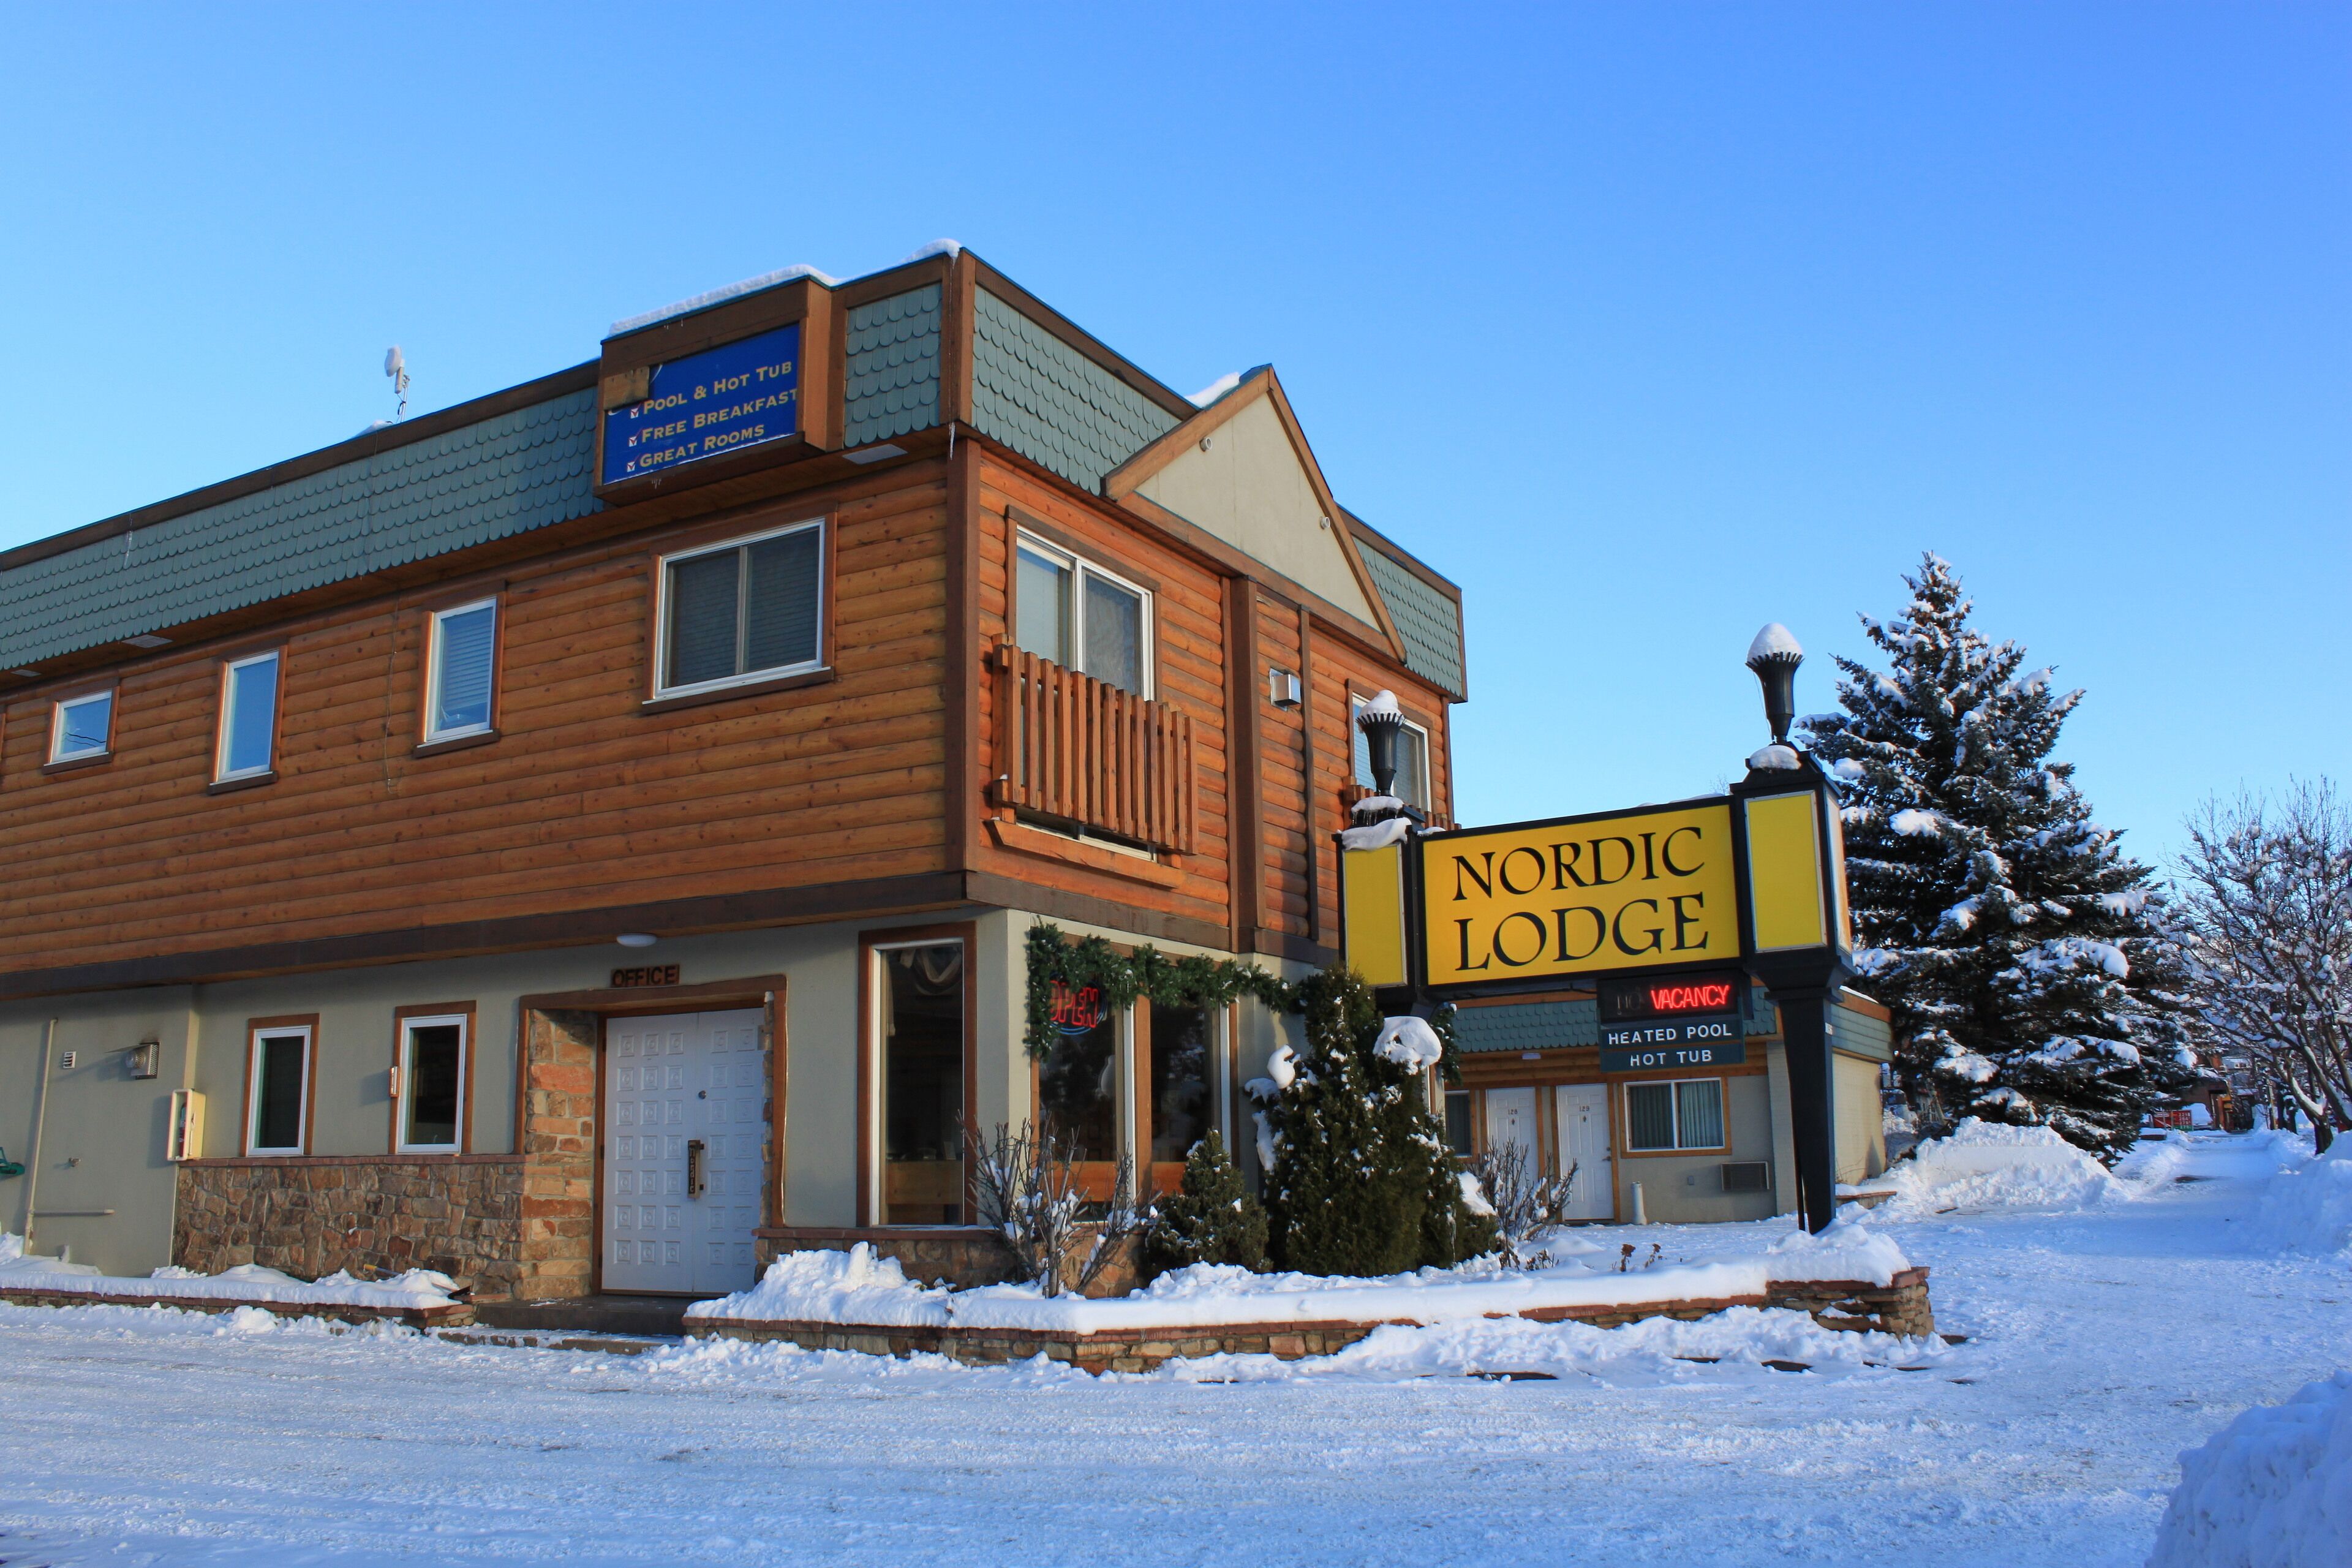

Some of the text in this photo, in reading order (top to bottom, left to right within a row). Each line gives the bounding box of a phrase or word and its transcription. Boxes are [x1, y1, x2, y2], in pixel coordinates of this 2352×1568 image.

[643, 361, 792, 415] POOL & HOT TUB
[641, 388, 797, 443] FREE BREAKFAST
[639, 424, 764, 468] GREAT ROOMS
[1452, 826, 1706, 902] NORDIC
[1454, 892, 1709, 971] LODGE
[612, 965, 677, 987] OFFICE
[1651, 985, 1730, 1009] VACANCY
[1608, 1023, 1732, 1045] HEATED POOL
[1630, 1050, 1712, 1066] HOT TUB
